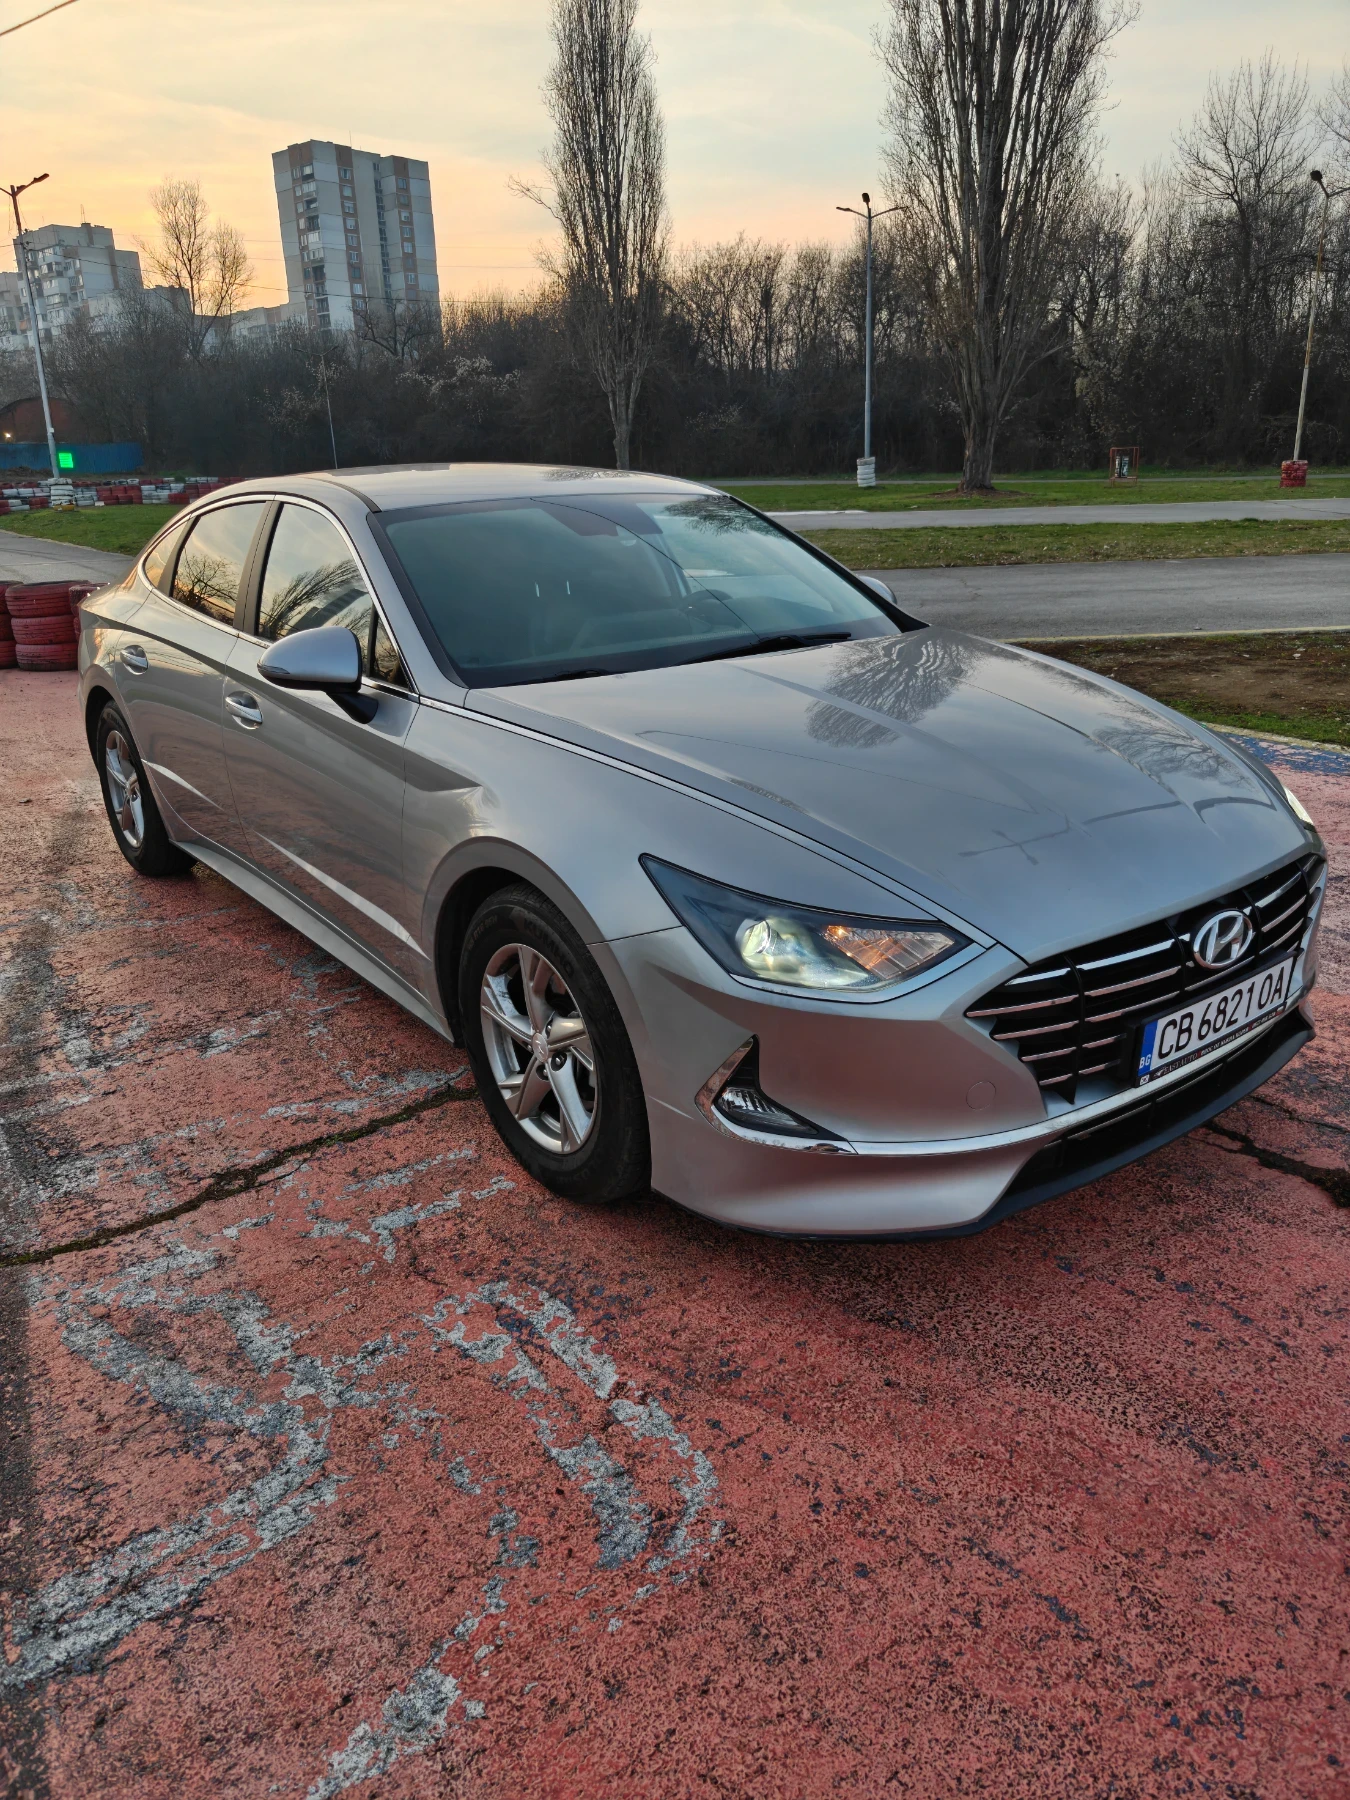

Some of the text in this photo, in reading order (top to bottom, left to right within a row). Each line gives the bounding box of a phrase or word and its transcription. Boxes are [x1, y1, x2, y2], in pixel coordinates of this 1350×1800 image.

[1157, 1011, 1194, 1060] CB
[1197, 981, 1255, 1041] 6821
[1257, 966, 1285, 1010] OA
[1138, 1053, 1152, 1069] BG
